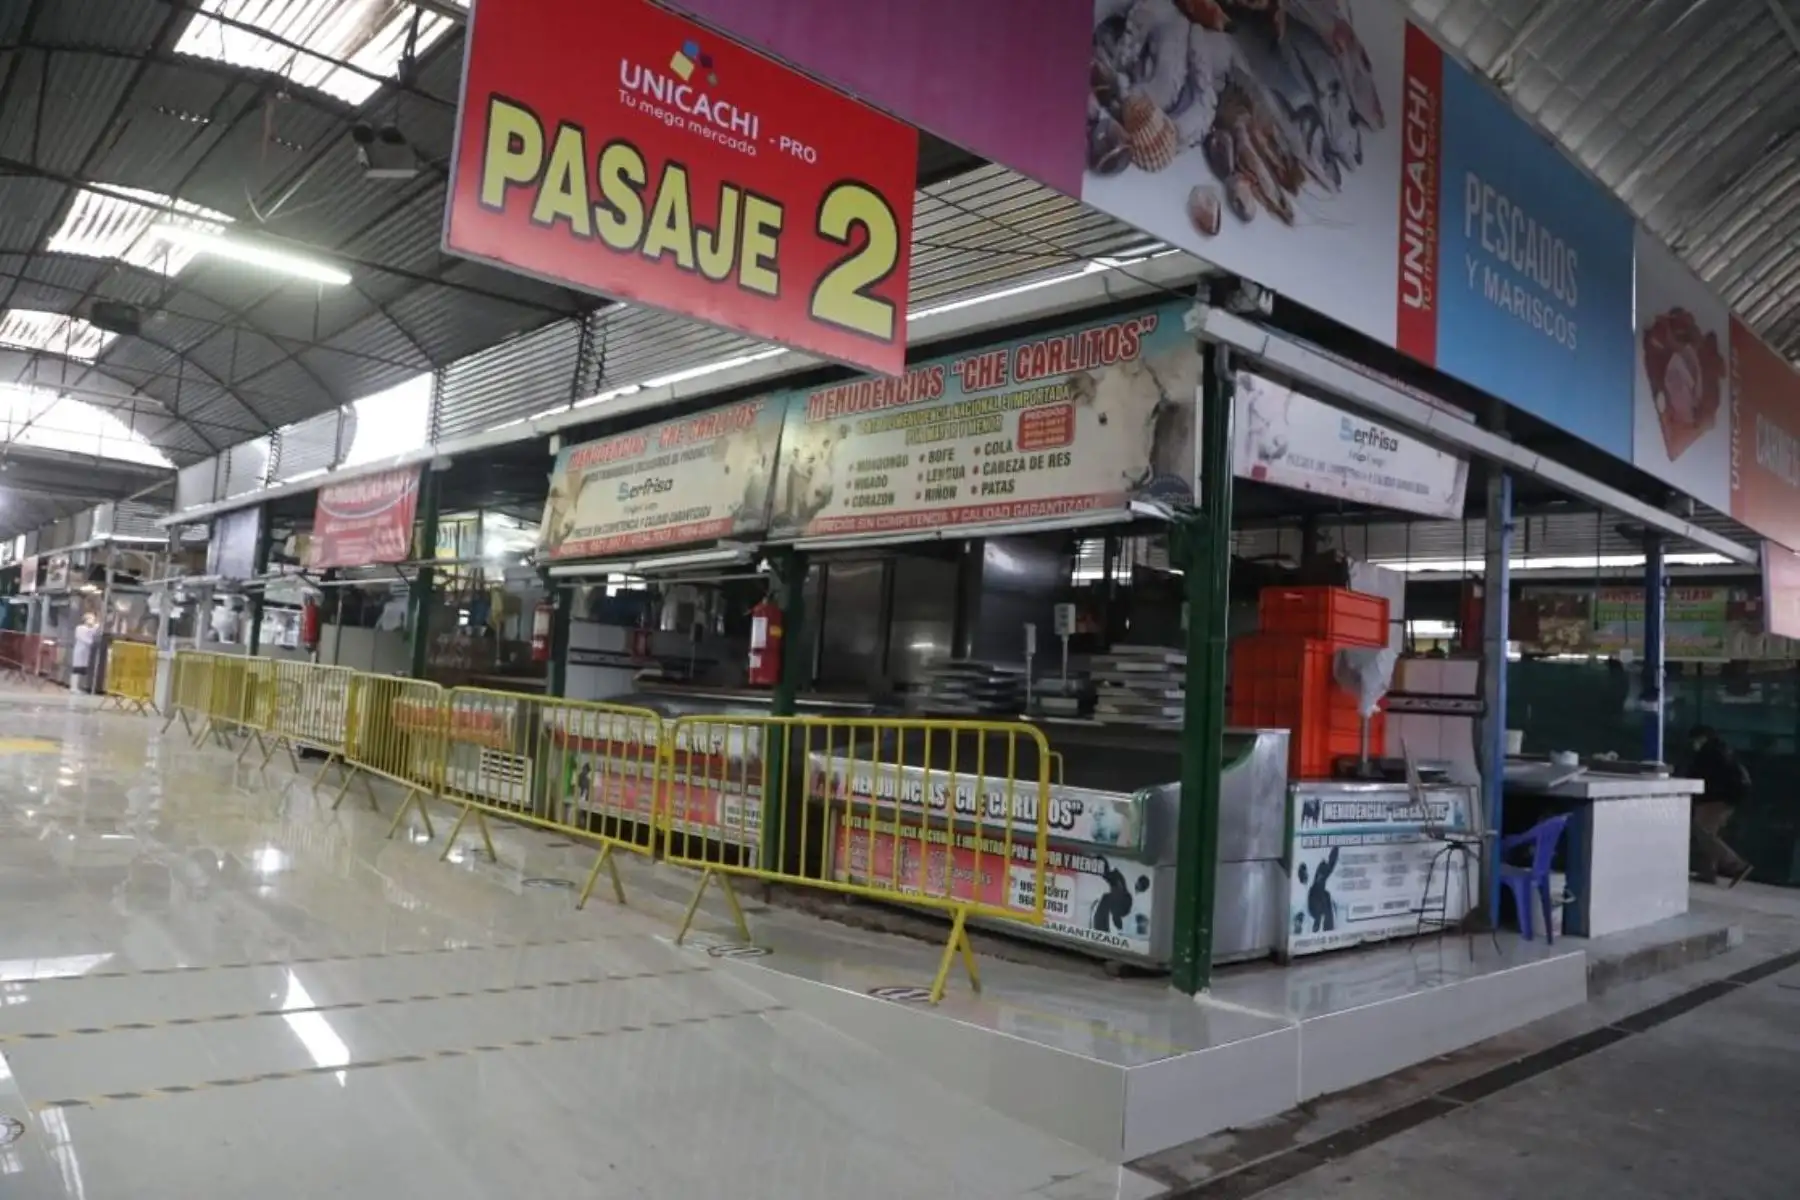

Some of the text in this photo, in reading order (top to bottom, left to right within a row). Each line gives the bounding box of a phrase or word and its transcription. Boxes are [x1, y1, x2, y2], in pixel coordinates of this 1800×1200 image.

[618, 89, 757, 157] Tu mega mercado
[619, 58, 760, 141] UNICACHI
[778, 134, 818, 165] PRO
[478, 93, 901, 344] PASAJE 2
[1402, 75, 1429, 309] UNICACHI
[1463, 171, 1579, 309] PESCADOS
[1464, 251, 1579, 352] Y MARISCOS
[805, 363, 945, 425] MENUDENCIAS
[983, 452, 1072, 476] CABEZA DE RES
[984, 439, 1013, 456] COLA
[981, 479, 1016, 496] PATAS
